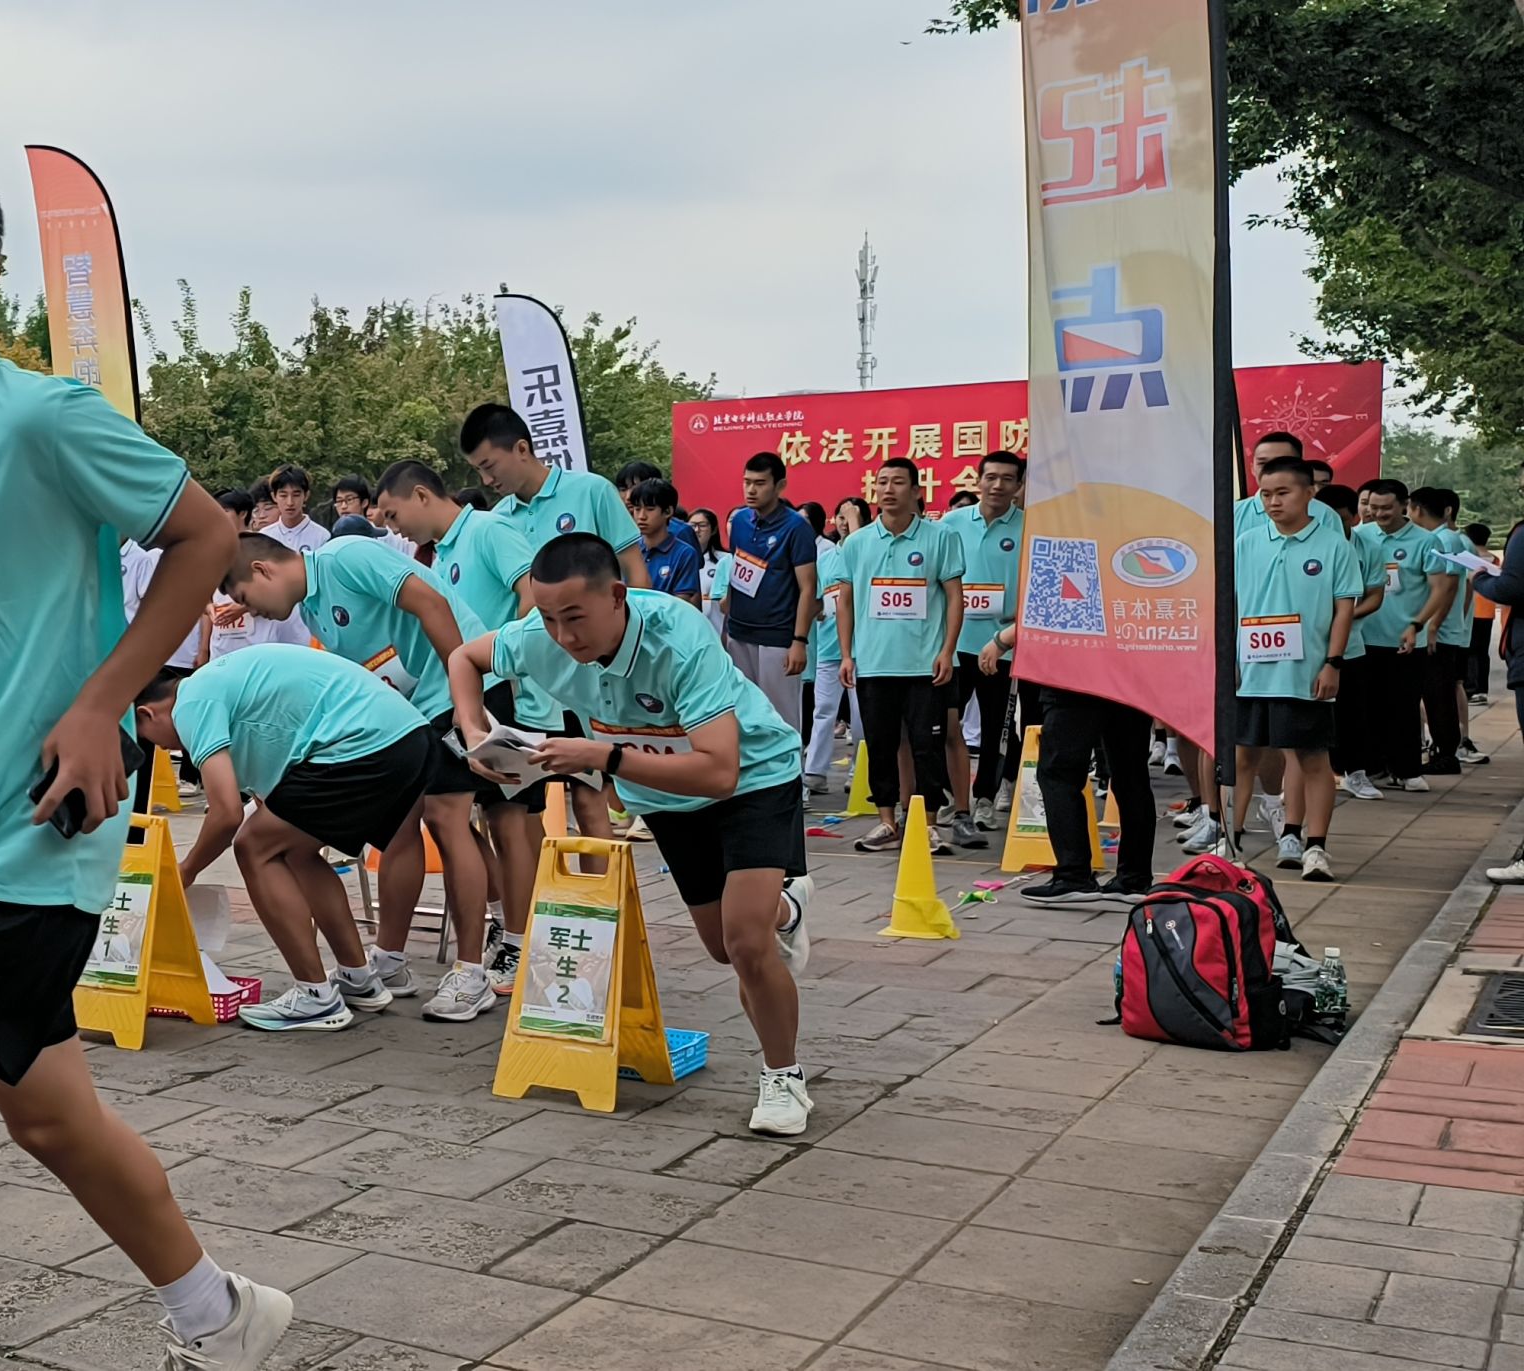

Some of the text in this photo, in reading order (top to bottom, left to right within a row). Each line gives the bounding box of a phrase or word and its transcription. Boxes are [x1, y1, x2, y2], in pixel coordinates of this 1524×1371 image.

[747, 421, 803, 429] POLYTECHNIC
[777, 419, 1028, 466] 依法开展国防
[733, 561, 754, 583] T03
[881, 592, 913, 607] S05
[1250, 631, 1286, 649] S06
[102, 915, 120, 935] 生
[104, 940, 111, 957] 1
[548, 926, 592, 952] 军士
[556, 955, 578, 979] 生
[557, 984, 570, 1004] 2
